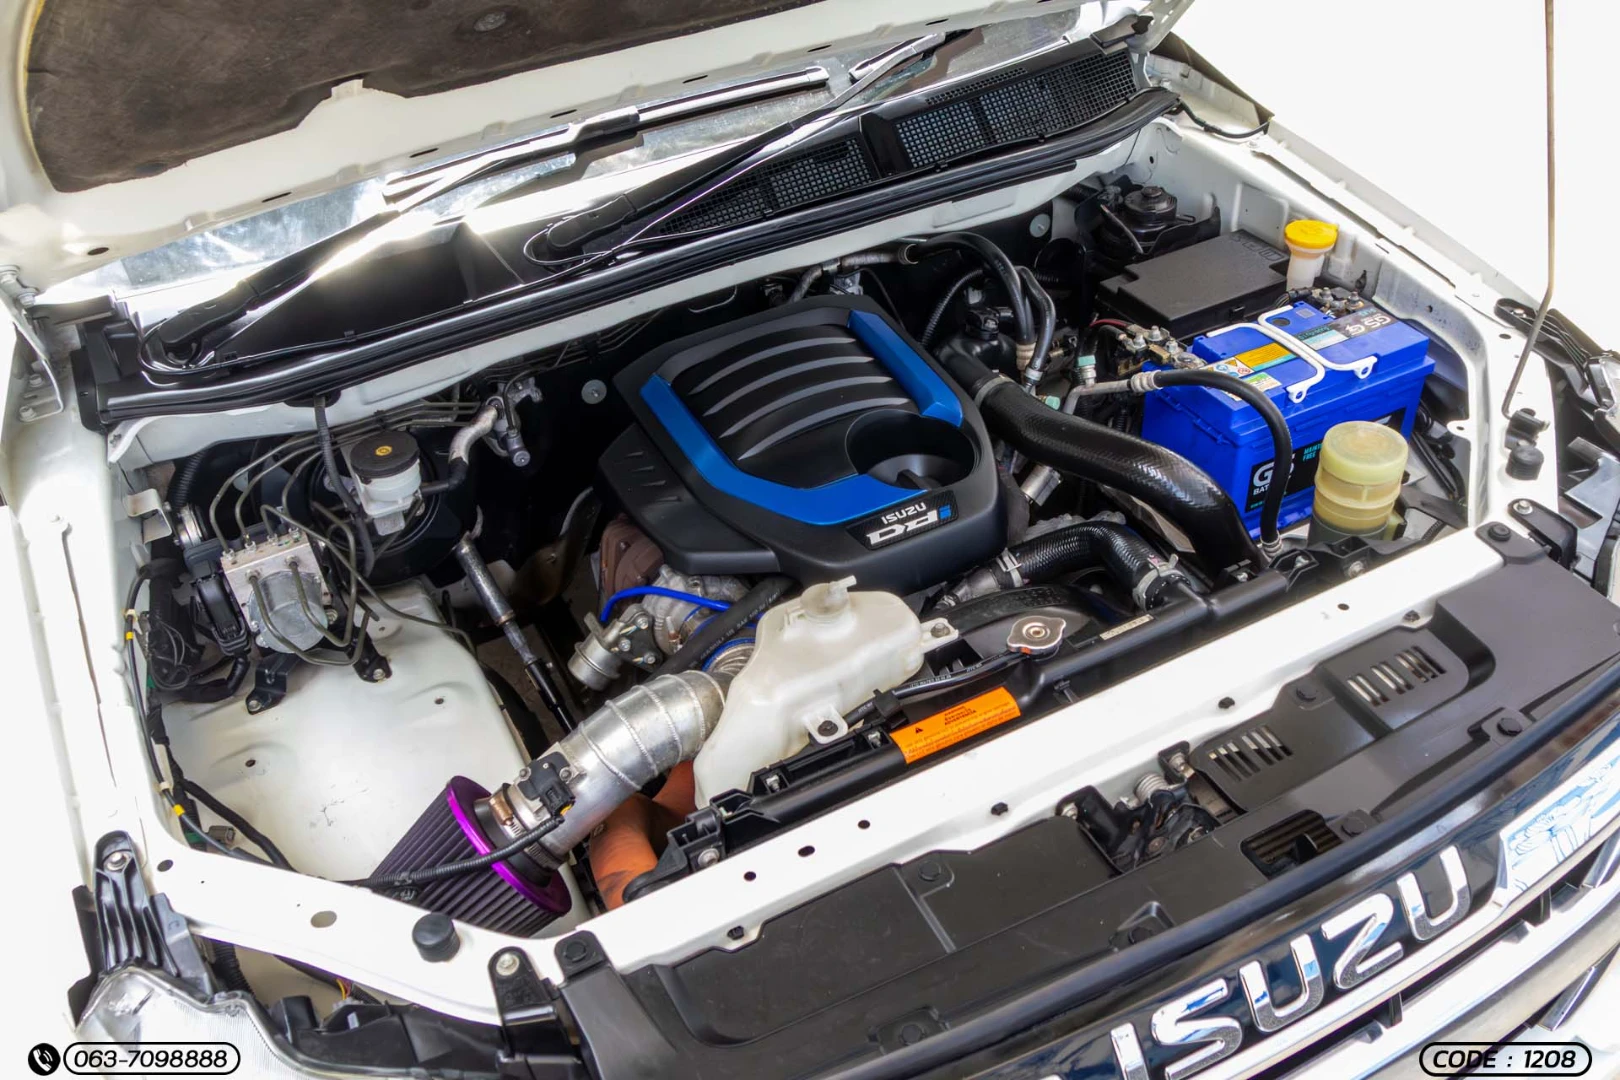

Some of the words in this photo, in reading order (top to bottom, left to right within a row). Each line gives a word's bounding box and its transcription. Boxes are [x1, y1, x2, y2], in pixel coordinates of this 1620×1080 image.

[1303, 443, 1322, 455] MAINT
[1253, 453, 1296, 487] G
[881, 502, 927, 525] ISUZU
[1109, 845, 1471, 1080] ISUZU
